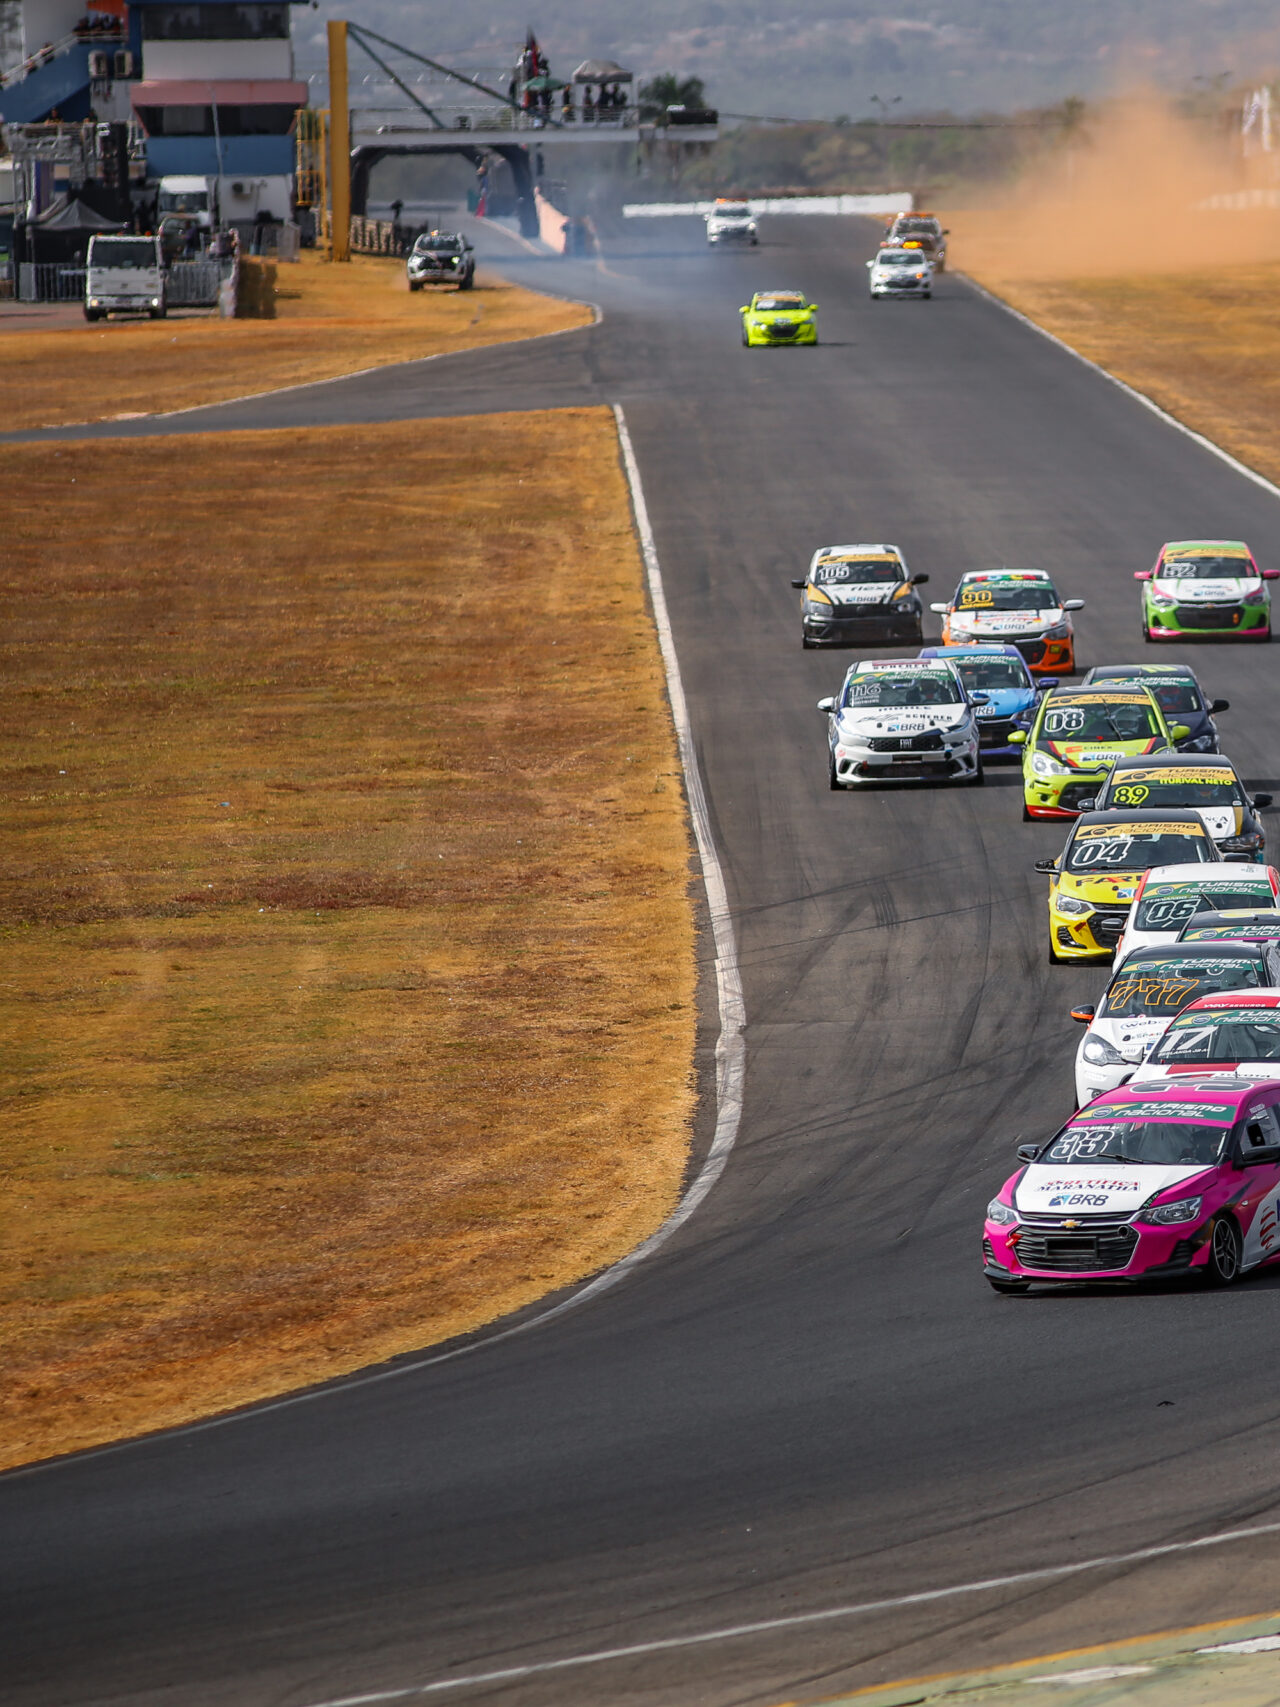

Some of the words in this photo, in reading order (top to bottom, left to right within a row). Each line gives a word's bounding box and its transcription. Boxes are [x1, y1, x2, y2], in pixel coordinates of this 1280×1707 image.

[900, 723, 926, 731] BRB
[1044, 711, 1085, 732] 08
[1113, 785, 1150, 805] 89
[1072, 840, 1132, 866] 04
[1146, 899, 1202, 923] 06
[1108, 977, 1200, 1010] 777
[1160, 1025, 1219, 1052] 17
[1140, 1103, 1228, 1113] TURISMO
[1050, 1130, 1116, 1159] 33
[1068, 1194, 1109, 1206] BRB
